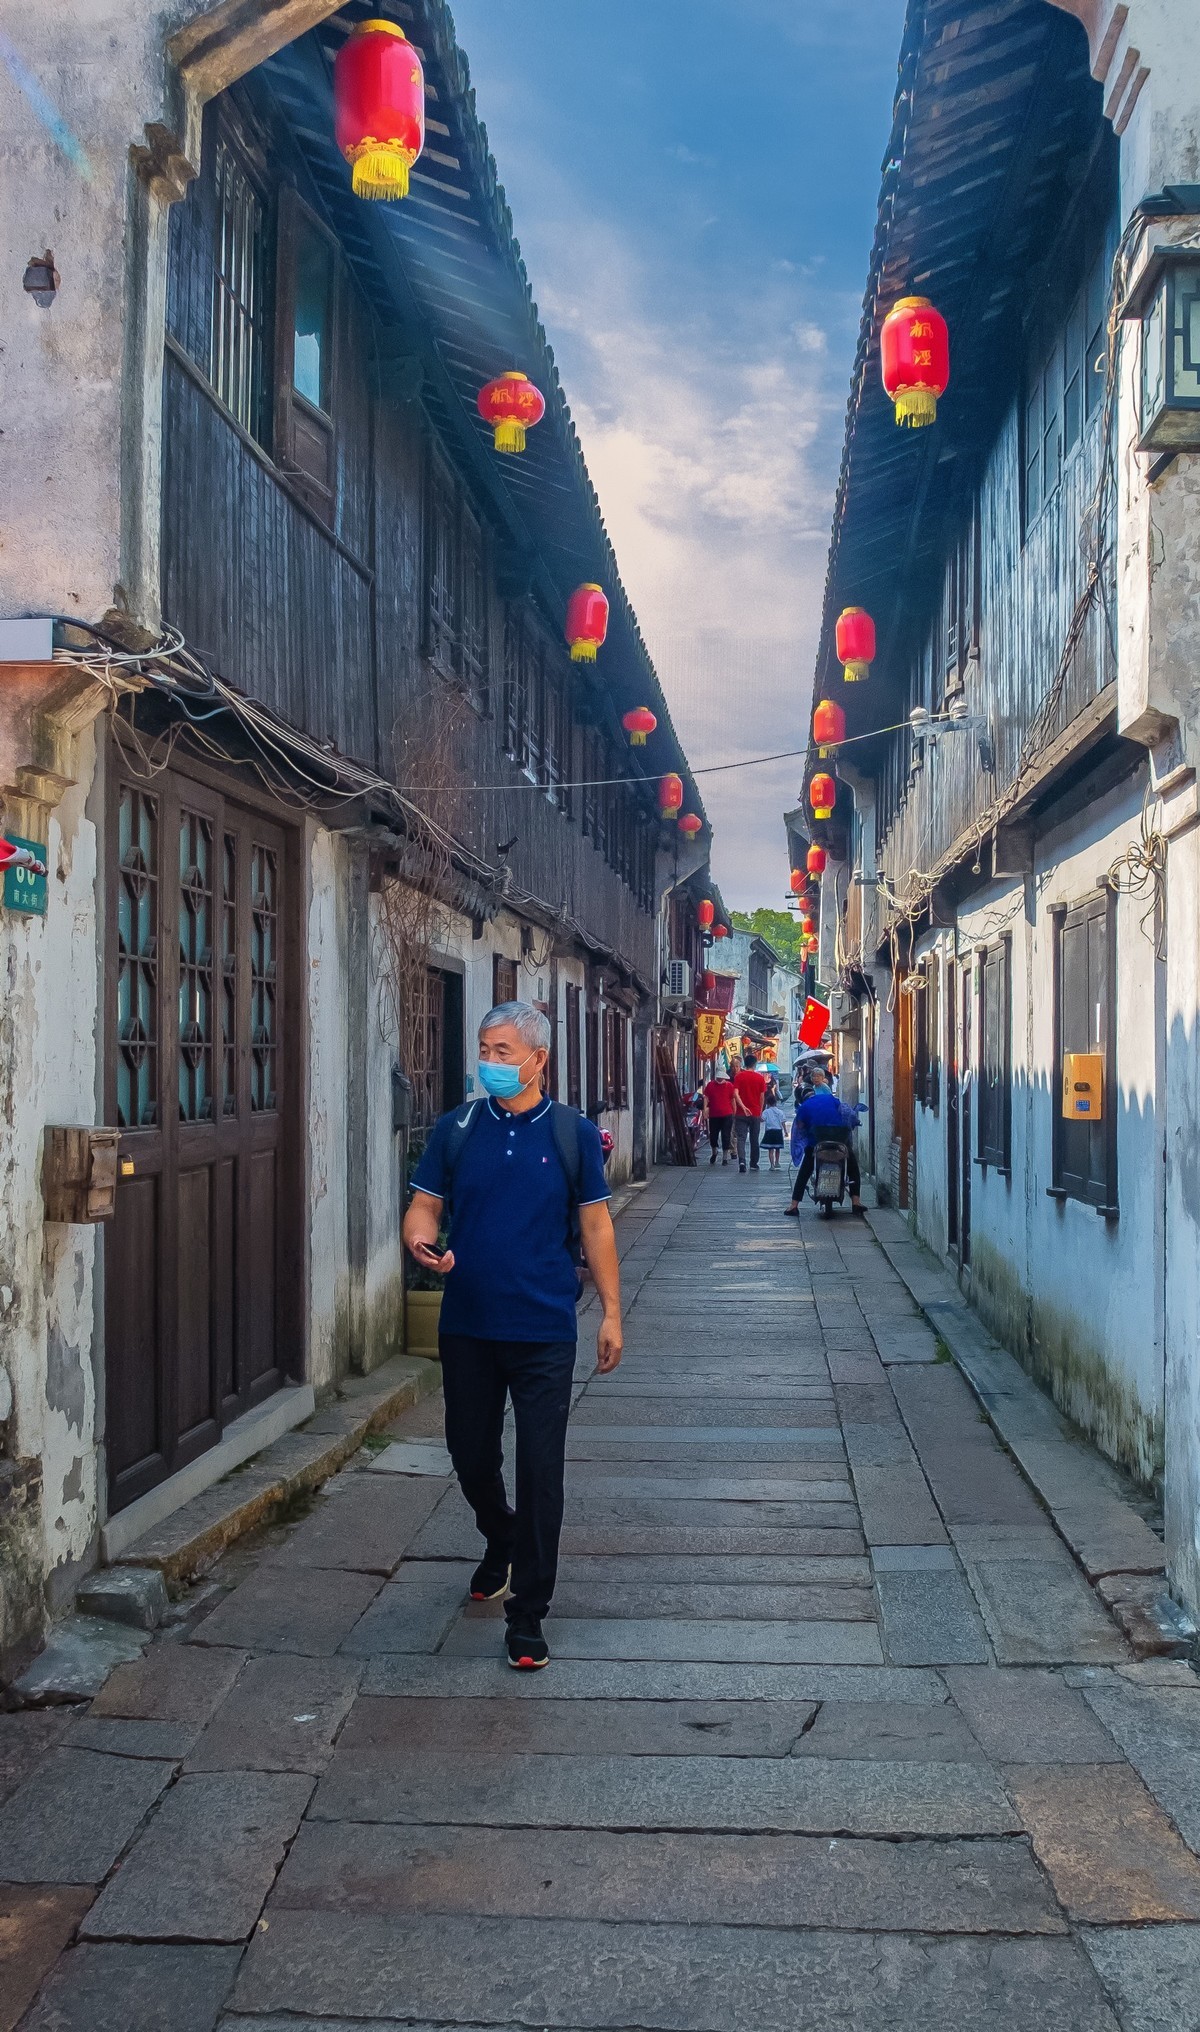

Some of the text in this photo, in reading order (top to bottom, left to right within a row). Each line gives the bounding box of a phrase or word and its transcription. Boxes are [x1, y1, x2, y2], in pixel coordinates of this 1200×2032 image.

[13, 888, 38, 907] 南大街
[702, 1016, 715, 1044] 理发店
